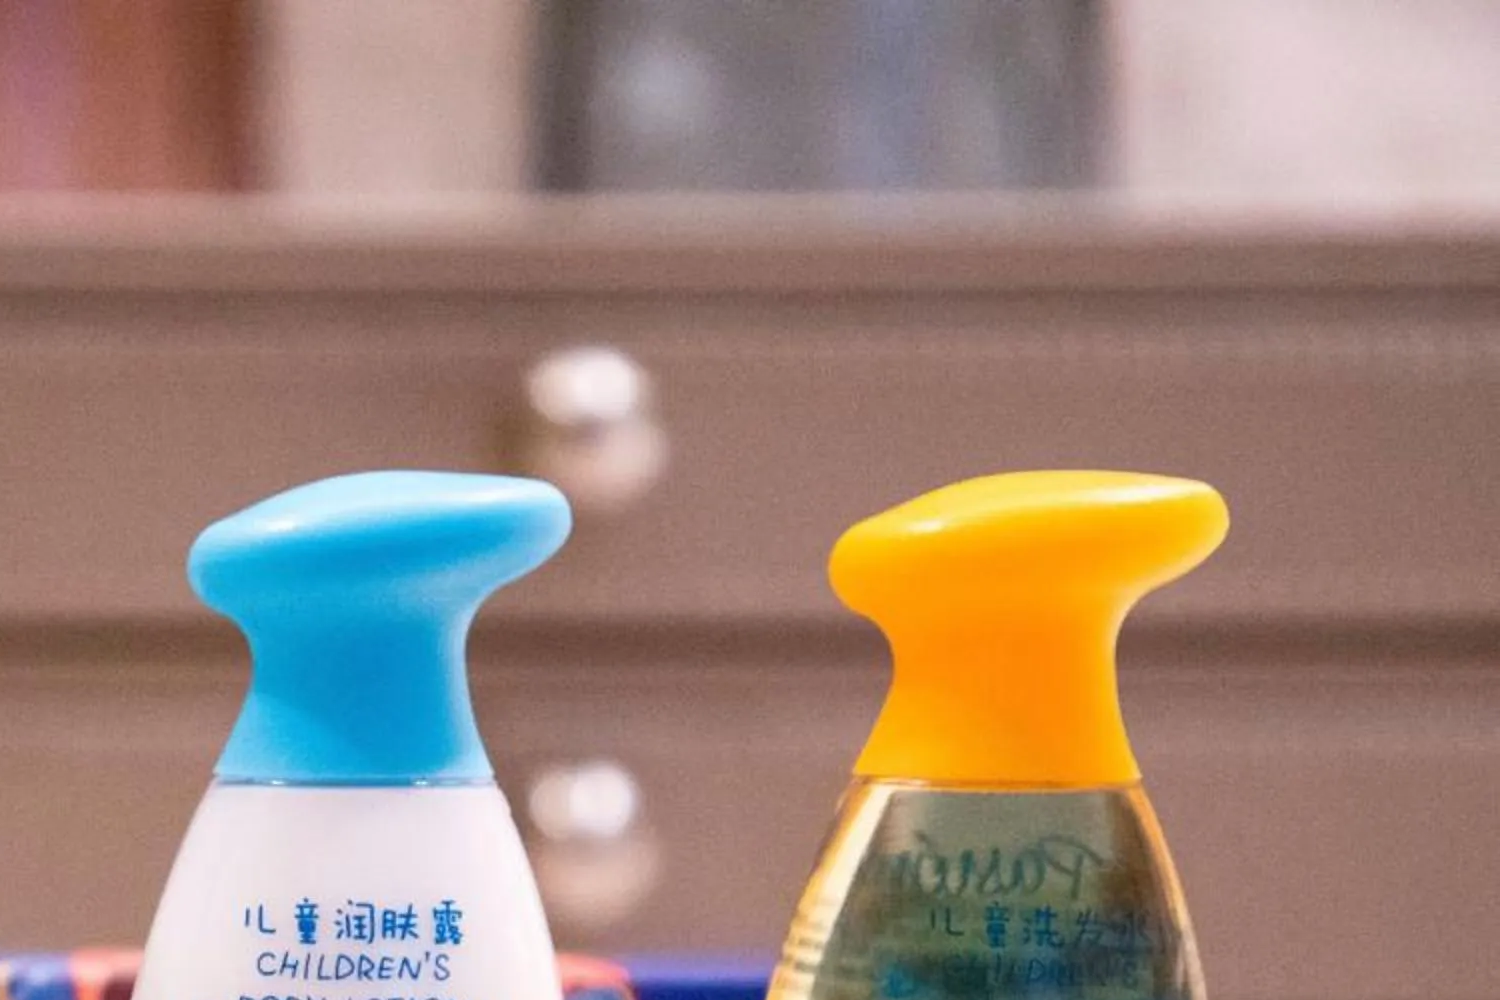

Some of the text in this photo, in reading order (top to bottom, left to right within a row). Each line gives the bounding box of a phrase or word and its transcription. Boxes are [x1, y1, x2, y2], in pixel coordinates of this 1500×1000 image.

[244, 898, 463, 946] 儿童润肤露
[257, 950, 451, 982] CHILDREN'S
